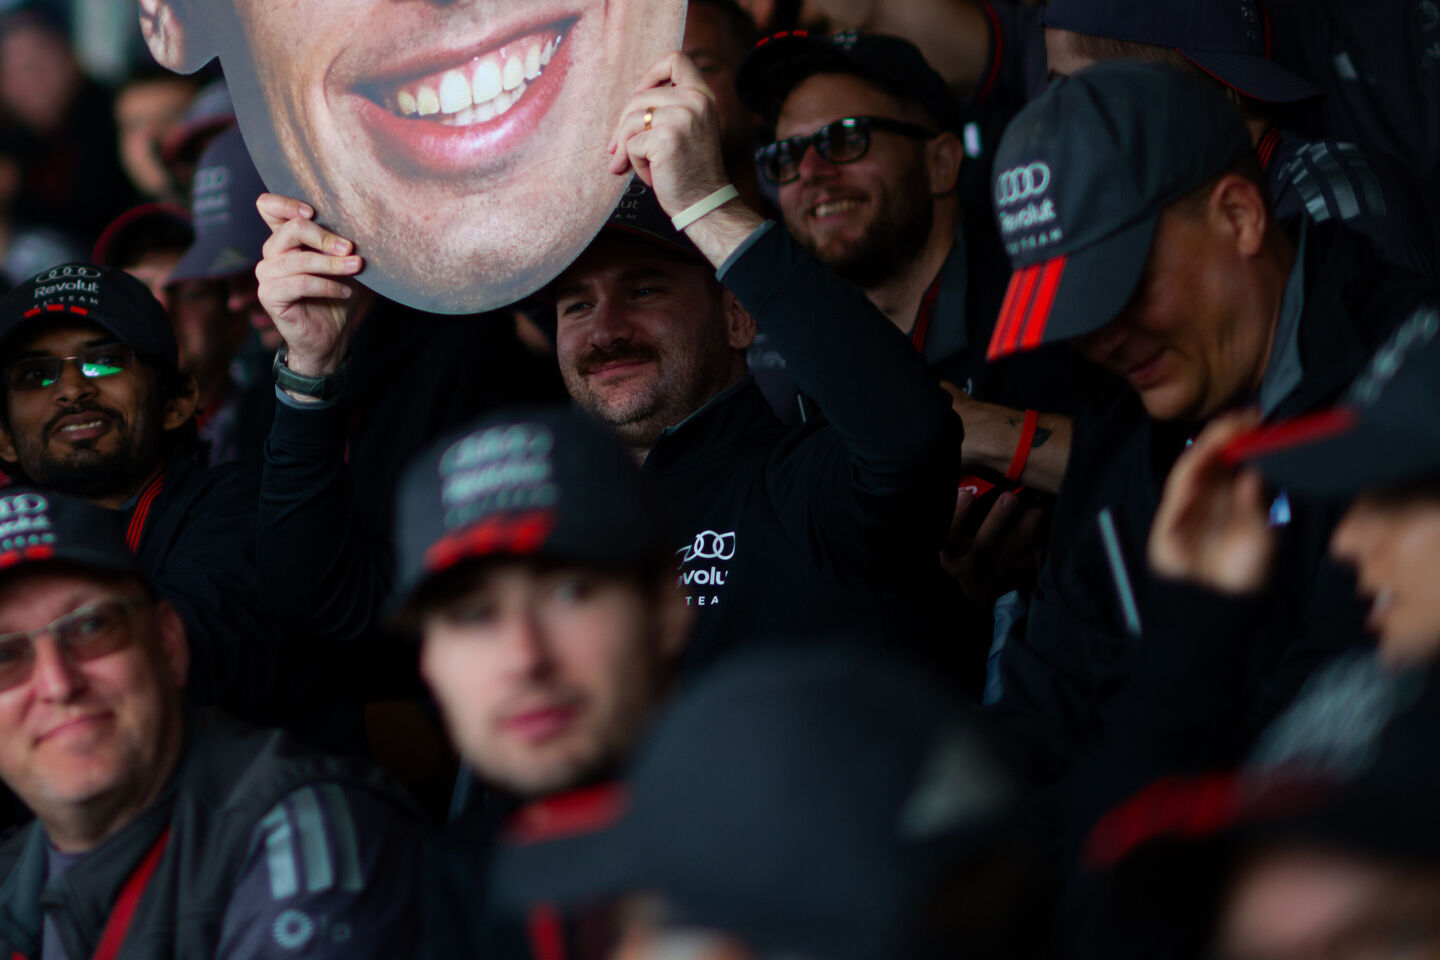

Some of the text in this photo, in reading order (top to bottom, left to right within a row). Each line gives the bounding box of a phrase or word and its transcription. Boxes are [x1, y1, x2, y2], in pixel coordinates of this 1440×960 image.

[34, 279, 100, 298] Revolut
[59, 295, 98, 305] TEAM
[685, 595, 719, 606] TEA
